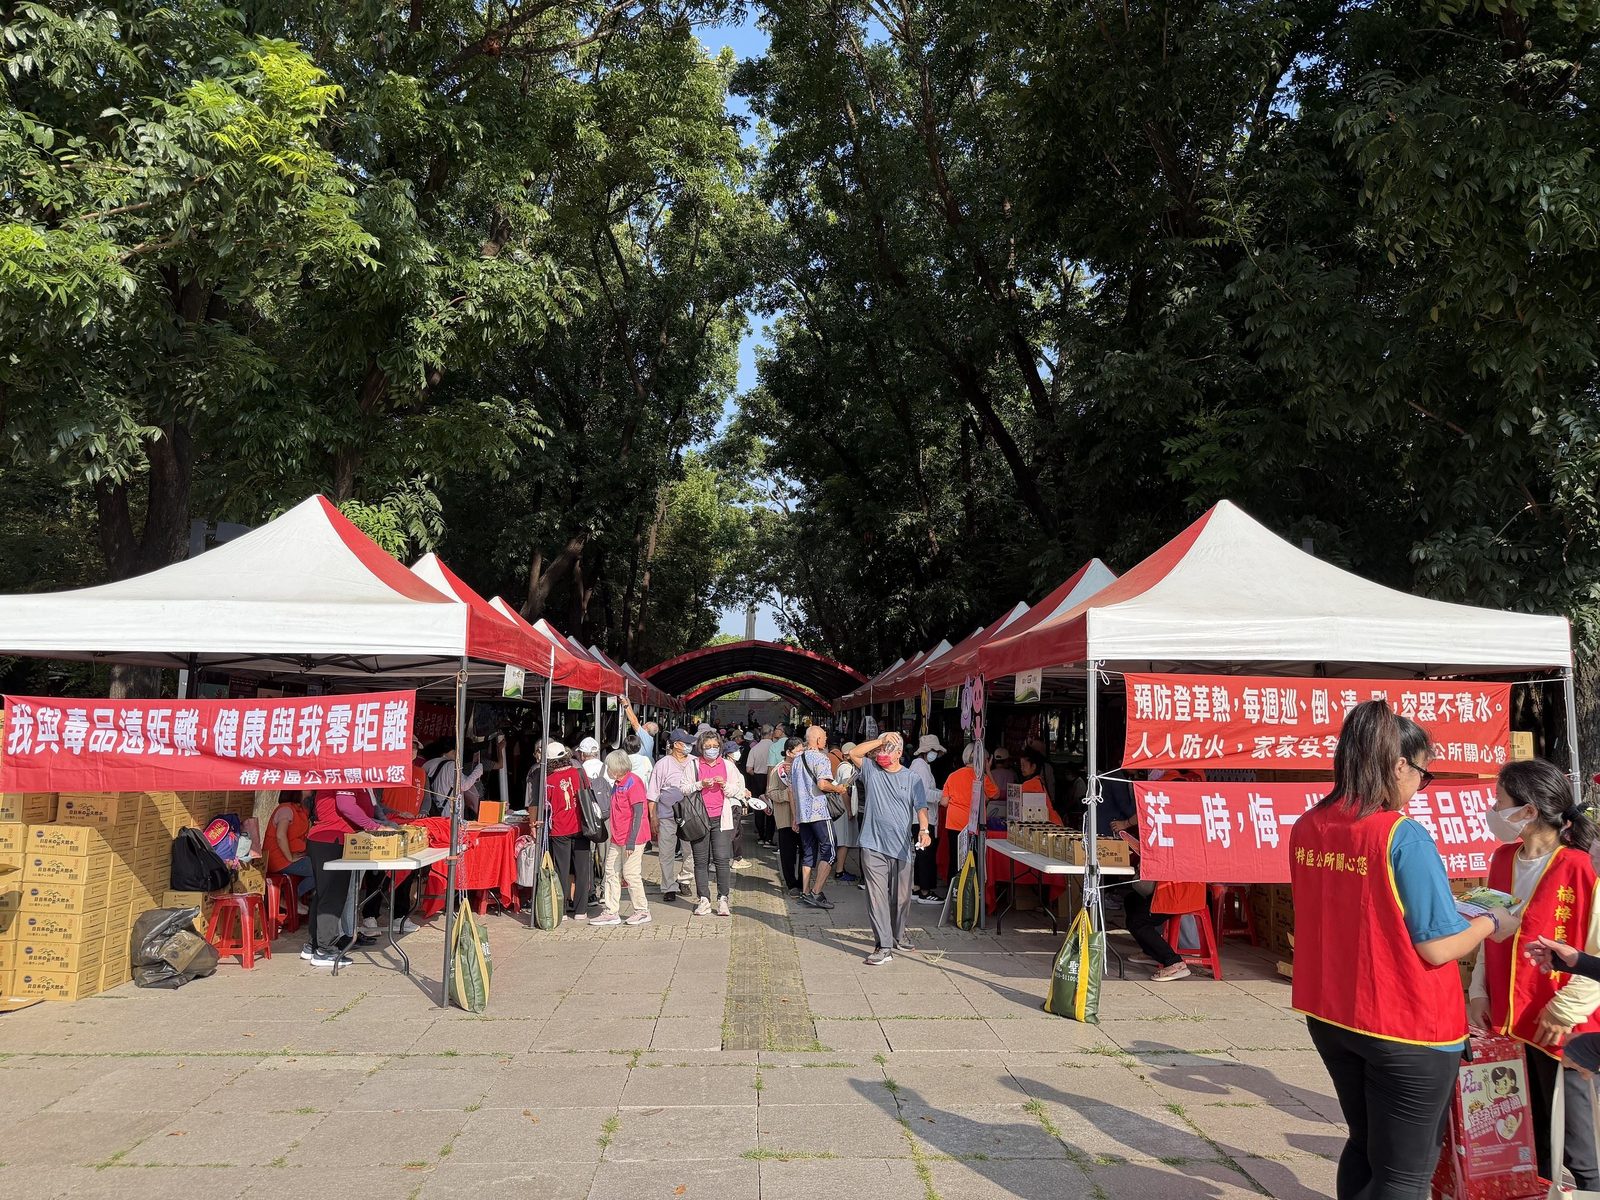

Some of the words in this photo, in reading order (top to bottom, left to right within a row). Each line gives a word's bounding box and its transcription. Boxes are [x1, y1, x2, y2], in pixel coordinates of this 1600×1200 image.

[239, 765, 407, 786] 楠梓區公所關心您
